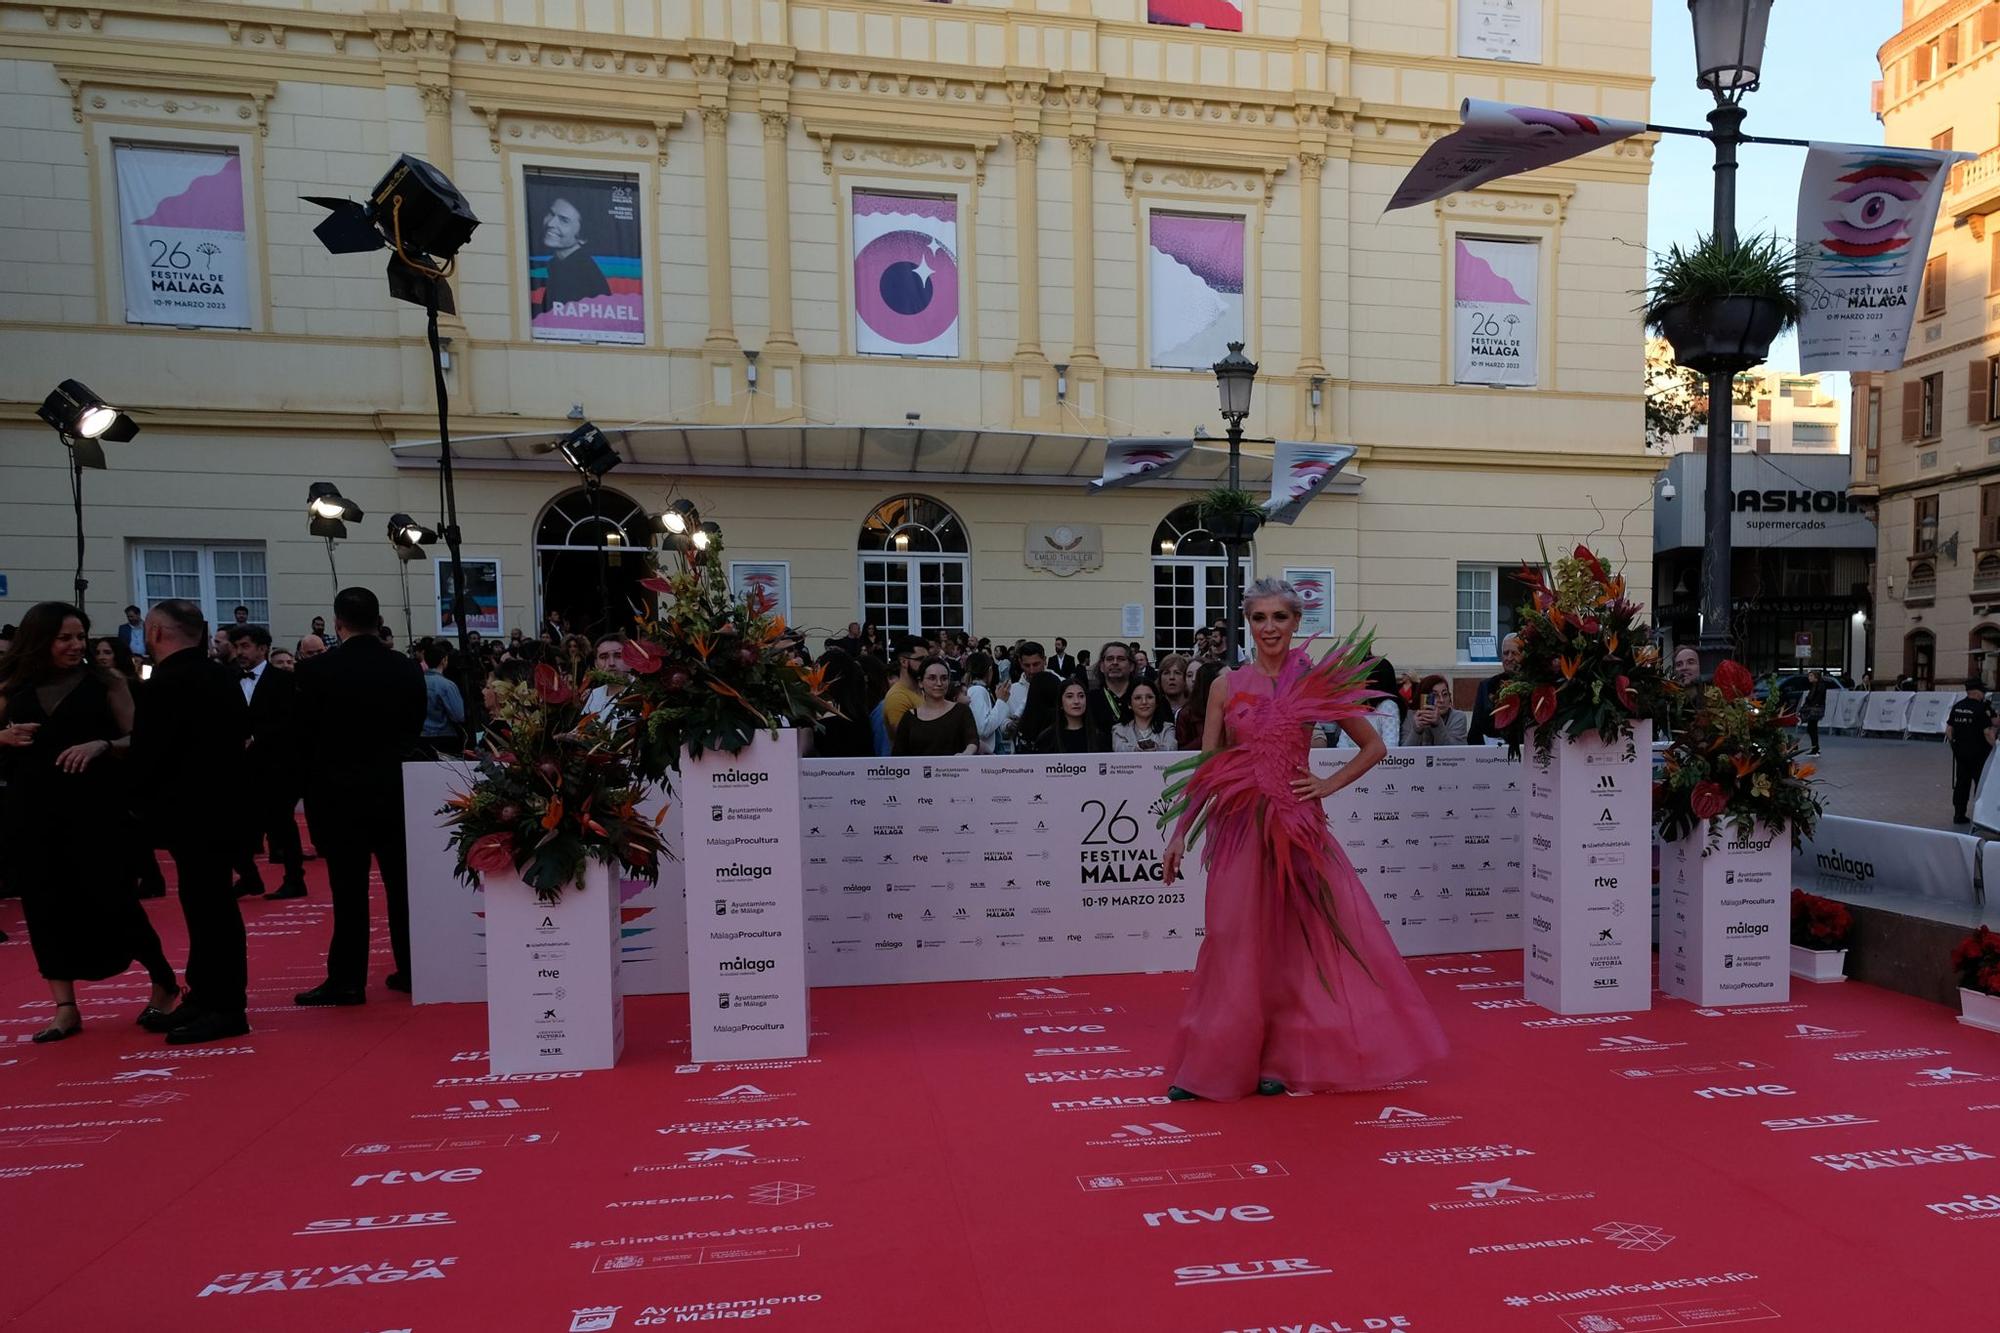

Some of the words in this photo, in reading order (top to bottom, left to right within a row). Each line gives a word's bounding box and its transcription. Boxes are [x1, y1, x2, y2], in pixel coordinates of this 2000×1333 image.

[150, 240, 191, 269] 26
[151, 270, 205, 281] FESTIVAL
[209, 274, 224, 282] DE
[1849, 287, 1894, 295] FESTIVAL
[1897, 285, 1908, 293] DE
[174, 300, 204, 308] MARZO
[552, 301, 639, 321] RAPHAEL
[1472, 312, 1499, 336] 26
[1471, 337, 1507, 346] FESTIVAL
[1746, 520, 1826, 530] supermercados
[1355, 786, 1369, 794] rtve
[850, 798, 866, 806] rtve
[917, 797, 933, 805] rtve
[1081, 800, 1139, 845] 26
[912, 854, 928, 862] rtve
[1081, 849, 1157, 862] FESTIVAL
[1594, 876, 1618, 888] rtve
[731, 900, 776, 908] Ayuntamiento
[1082, 897, 1108, 907] 10-19
[1112, 895, 1155, 906] MARZO
[1158, 893, 1185, 904] 2023
[888, 912, 903, 920] rtve
[1067, 934, 1081, 942] rtve
[538, 968, 560, 979] rtve
[734, 993, 779, 1001] Ayuntamiento
[1023, 1024, 1106, 1035] rtve
[1693, 1083, 1797, 1100] rtve
[1052, 1095, 1172, 1110] málag
[655, 1120, 812, 1135] VICTORIA
[1761, 1113, 1868, 1128] SUR
[1378, 1148, 1536, 1165] VICTORIA
[1386, 1143, 1513, 1158] CERVEZAS
[1810, 1147, 1934, 1163] FESTIVAL
[1936, 1142, 1974, 1151] DE
[632, 1160, 724, 1173] Fundación
[351, 1167, 485, 1187] rtve
[605, 1193, 735, 1209] ATRESMEDIA
[1426, 1196, 1520, 1211] Fundación
[305, 1212, 449, 1230] SUR
[1143, 1204, 1275, 1228] rtve
[568, 1220, 834, 1249] #alimentosdespaña
[1468, 1236, 1594, 1255] ATRESMEDIA
[213, 1260, 394, 1282] FESTIVAL
[411, 1256, 459, 1269] DE
[1173, 1257, 1320, 1280] SUR
[1503, 1270, 1759, 1308] #alimentosdespaña
[639, 1292, 823, 1316] Ayuntamiento
[634, 1315, 667, 1326] de
[676, 1306, 772, 1324] Málaga
[1363, 1315, 1411, 1329] DE
